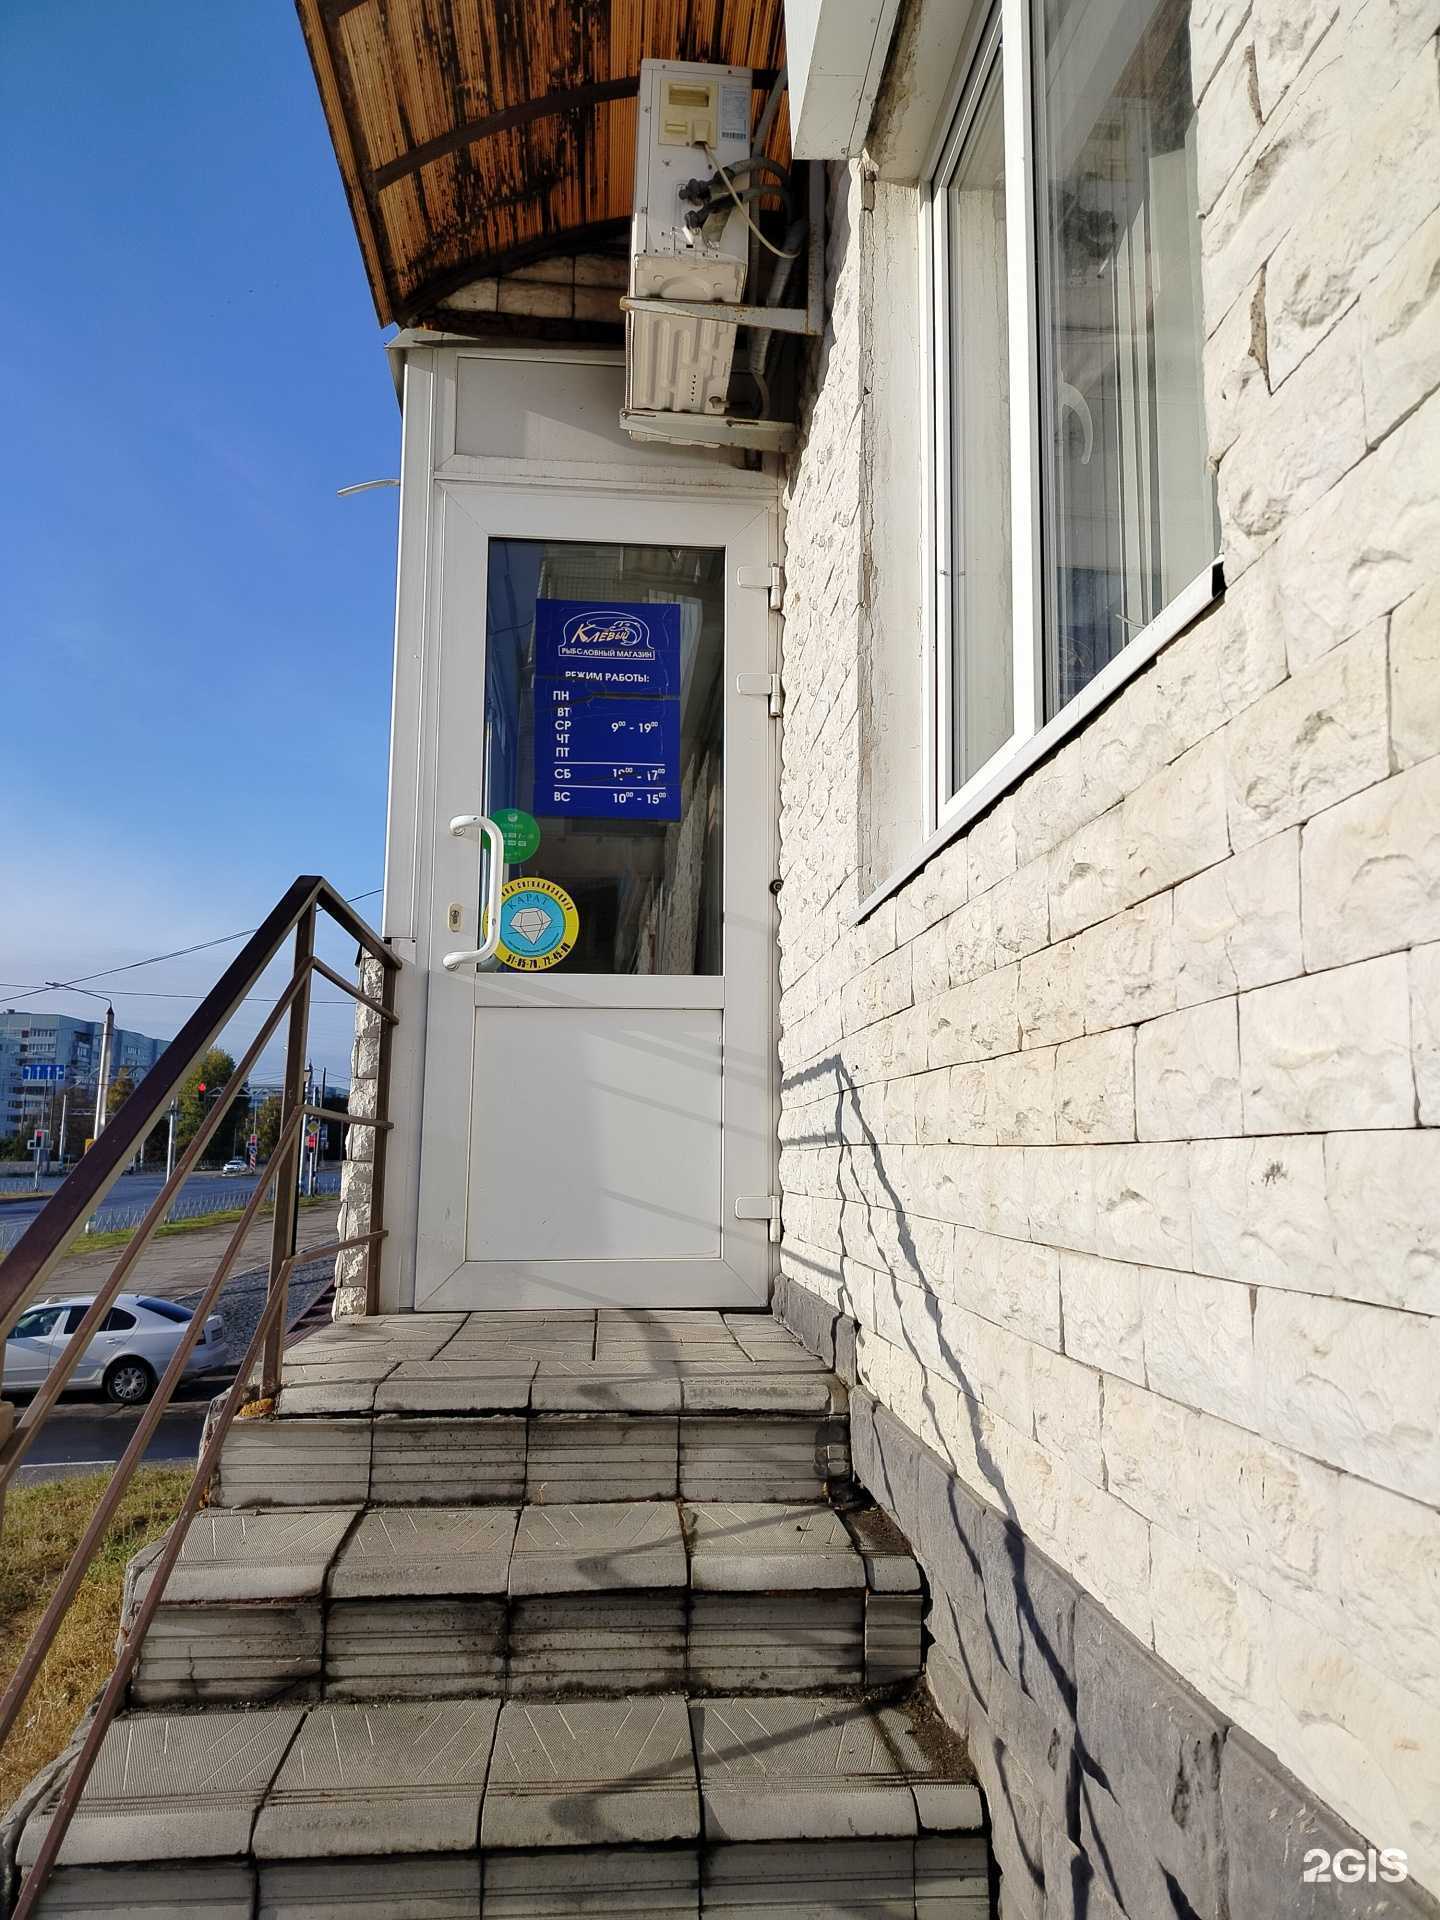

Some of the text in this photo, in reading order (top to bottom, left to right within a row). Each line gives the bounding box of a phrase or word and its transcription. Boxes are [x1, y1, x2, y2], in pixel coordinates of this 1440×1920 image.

[617, 649, 653, 658] МАГАЗИН
[565, 671, 650, 683] РЕЖИМ РАБОТЫ:
[552, 691, 570, 701] ПН
[557, 707, 571, 717] ВТ
[554, 720, 572, 730] СР
[556, 733, 570, 744] ЧТ
[555, 747, 570, 757] ПТ
[554, 768, 572, 779] СБ
[553, 792, 571, 802] ВС
